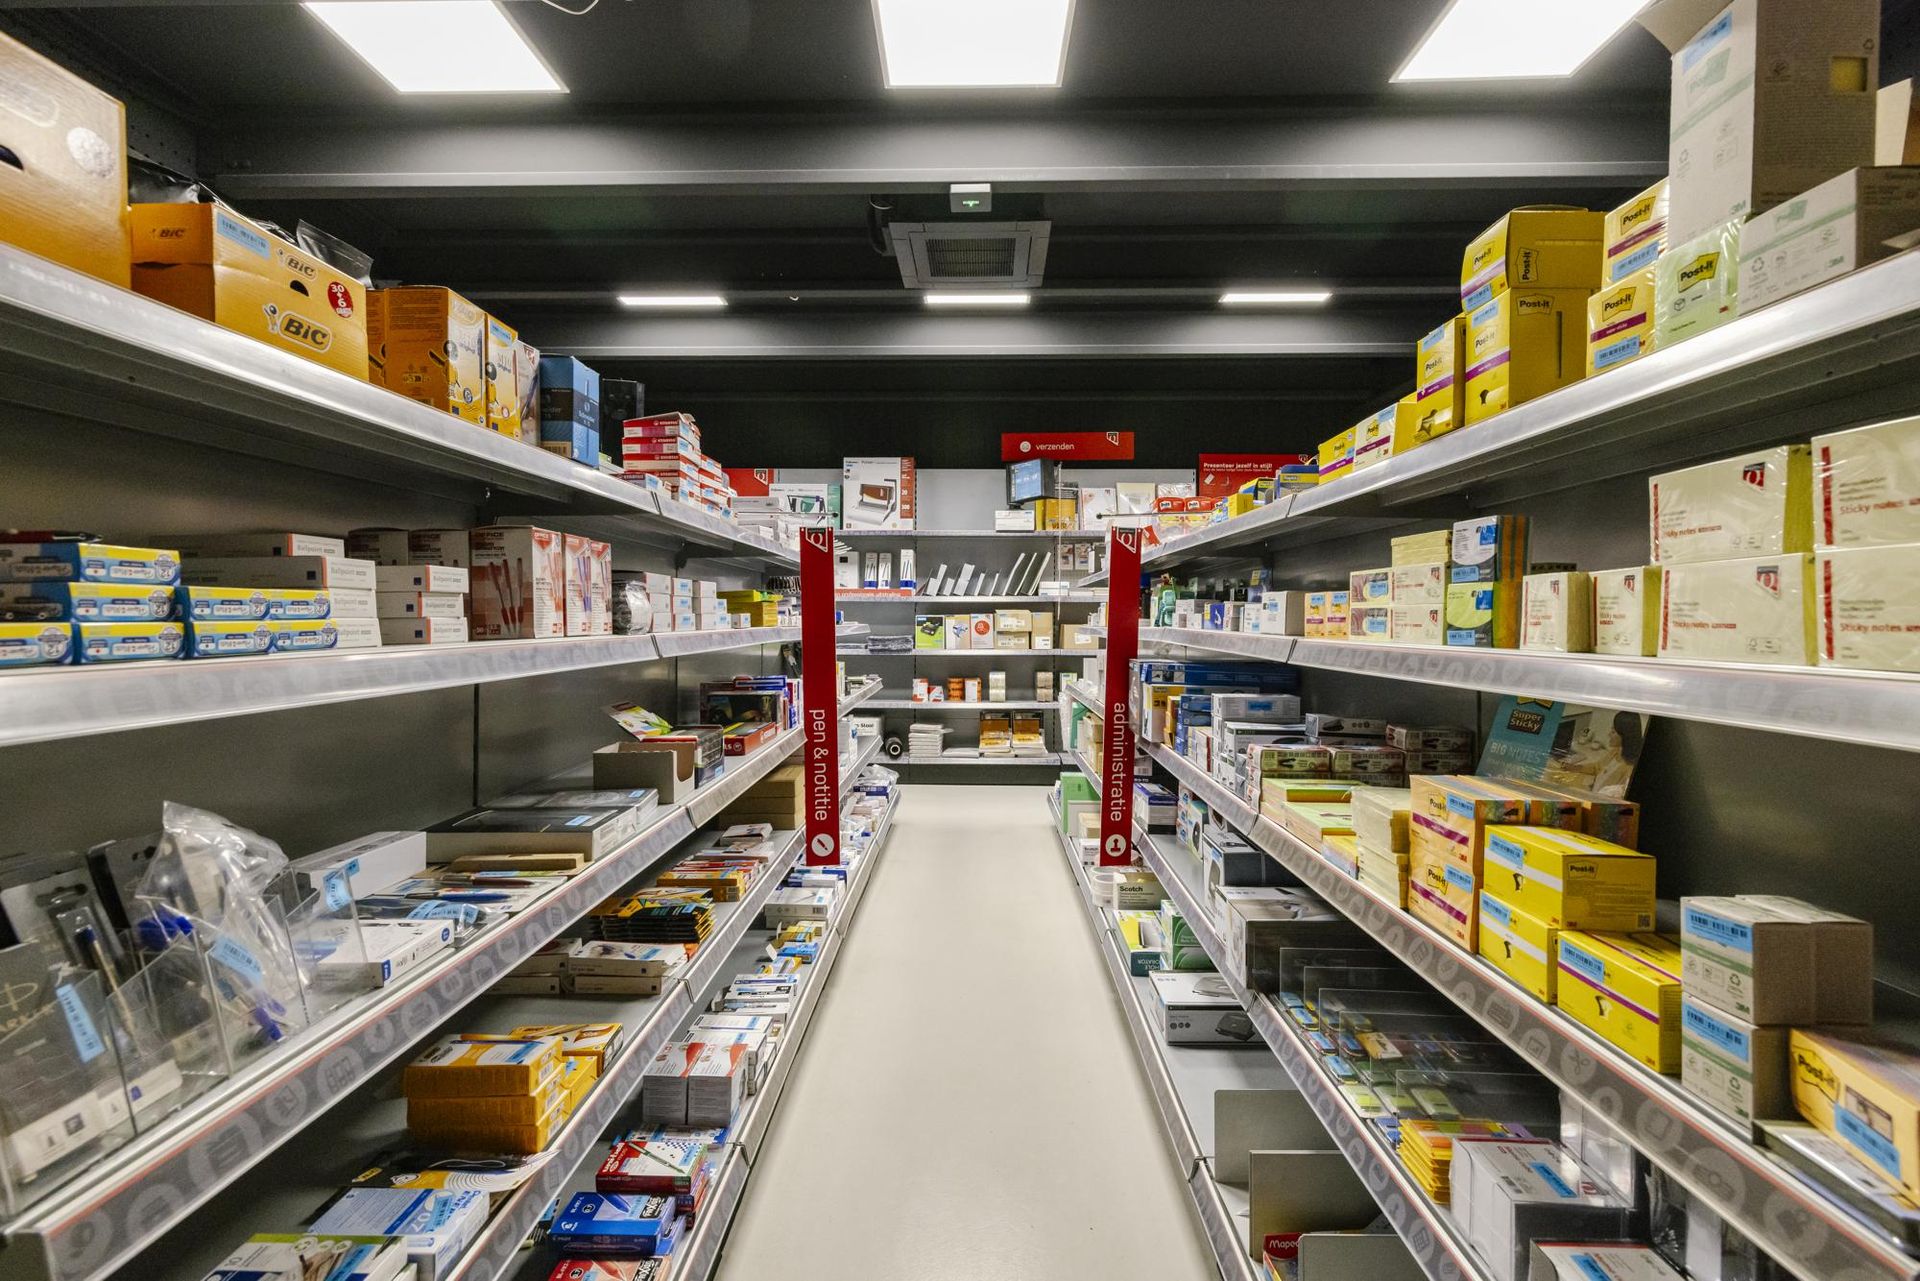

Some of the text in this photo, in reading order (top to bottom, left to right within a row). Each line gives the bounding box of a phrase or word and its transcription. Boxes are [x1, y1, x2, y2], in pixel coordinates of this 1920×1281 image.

[1623, 202, 1651, 226] Post-it
[1522, 251, 1531, 281] Post-it
[1680, 260, 1714, 282] Post-it
[330, 284, 345, 293] 30
[337, 298, 347, 308] 6
[1519, 300, 1551, 309] Post-it
[1604, 293, 1633, 313] Post-it
[1036, 442, 1076, 451] verzenden
[1840, 501, 1904, 516] Sticky notes
[1840, 622, 1902, 634] Sticky notes
[1512, 710, 1542, 721] Super
[1510, 718, 1540, 732] Sticky
[1490, 741, 1508, 756] BIG
[809, 709, 832, 821] pen & notitie
[1110, 702, 1126, 822] administratie
[1569, 864, 1595, 874] Post-it
[1798, 1053, 1836, 1089] Post-it
[602, 1142, 625, 1173] uni-ball
